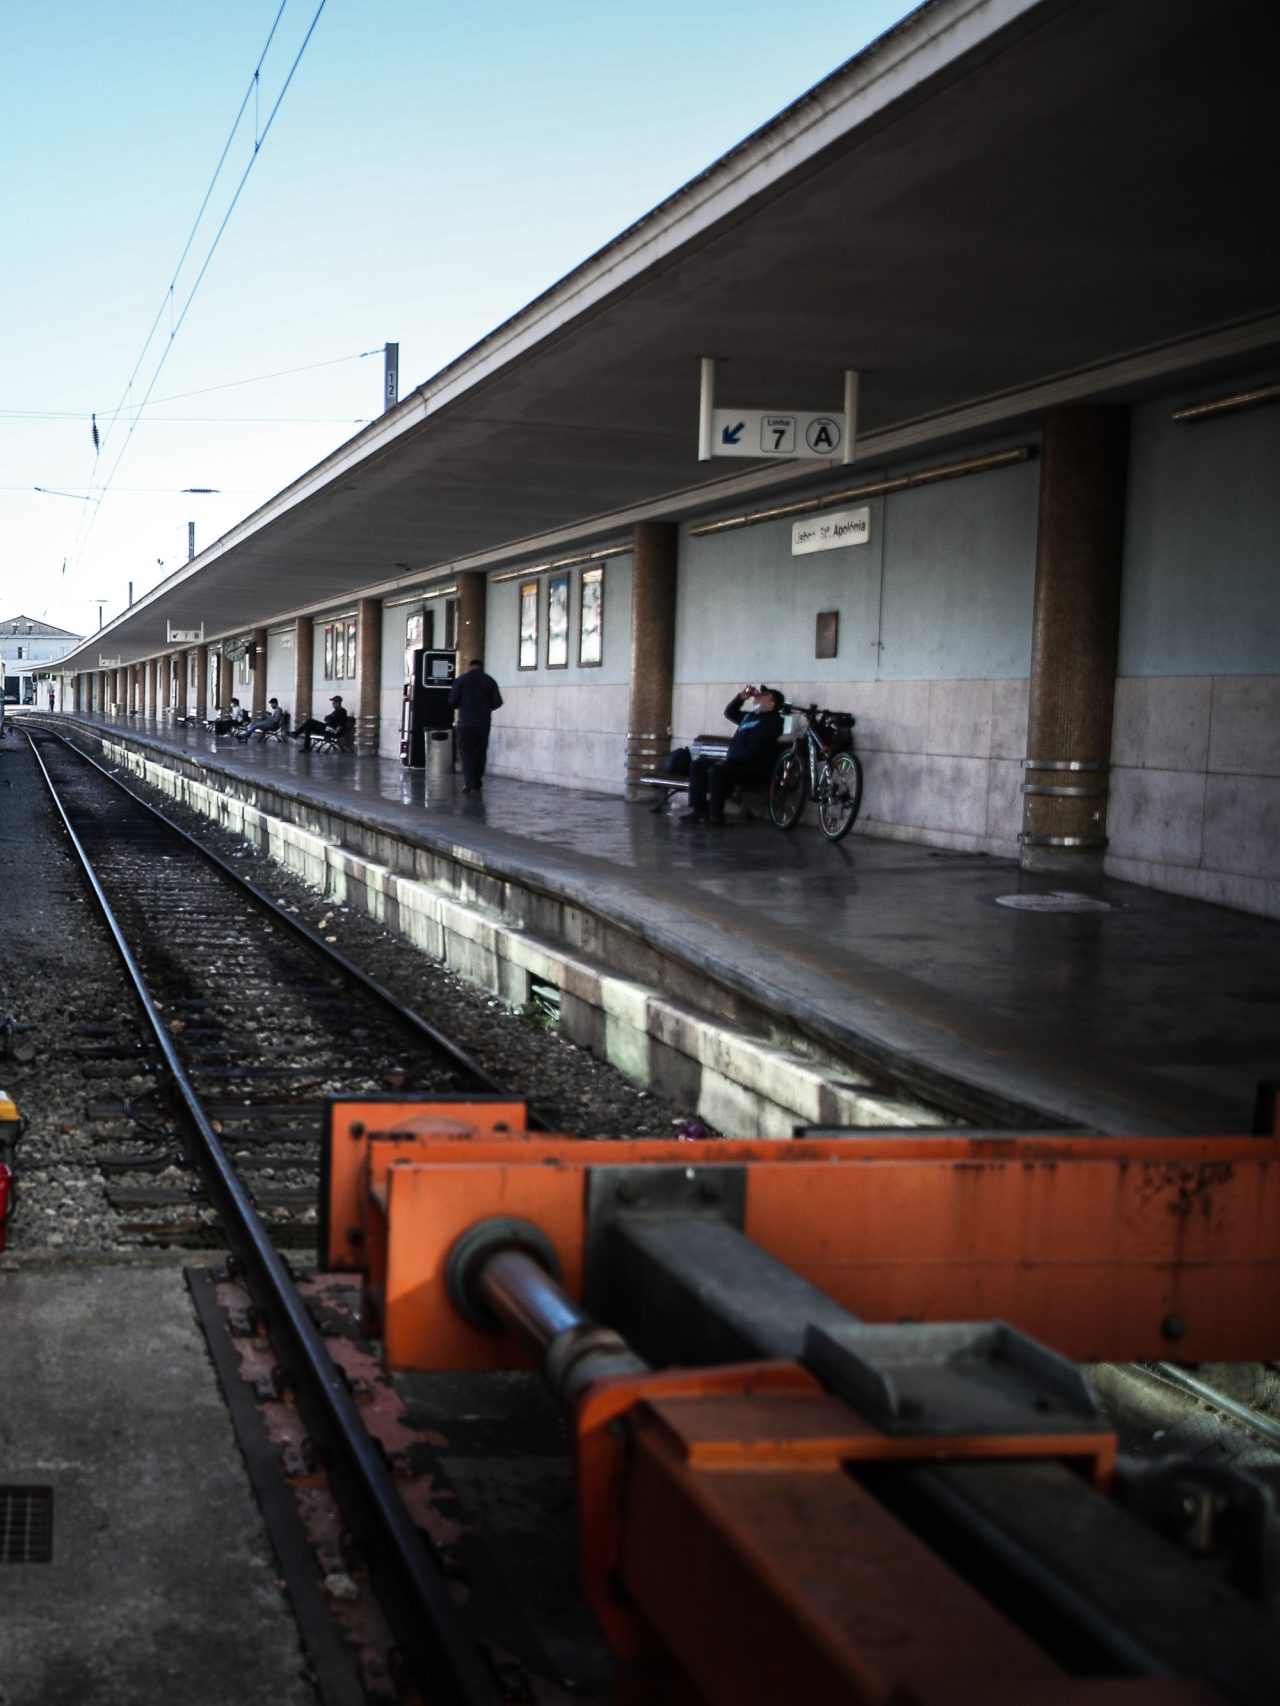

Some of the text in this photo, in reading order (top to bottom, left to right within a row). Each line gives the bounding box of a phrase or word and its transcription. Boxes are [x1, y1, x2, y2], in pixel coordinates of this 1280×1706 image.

[767, 418, 790, 427] Linha
[772, 429, 786, 450] 7
[813, 426, 833, 448] A
